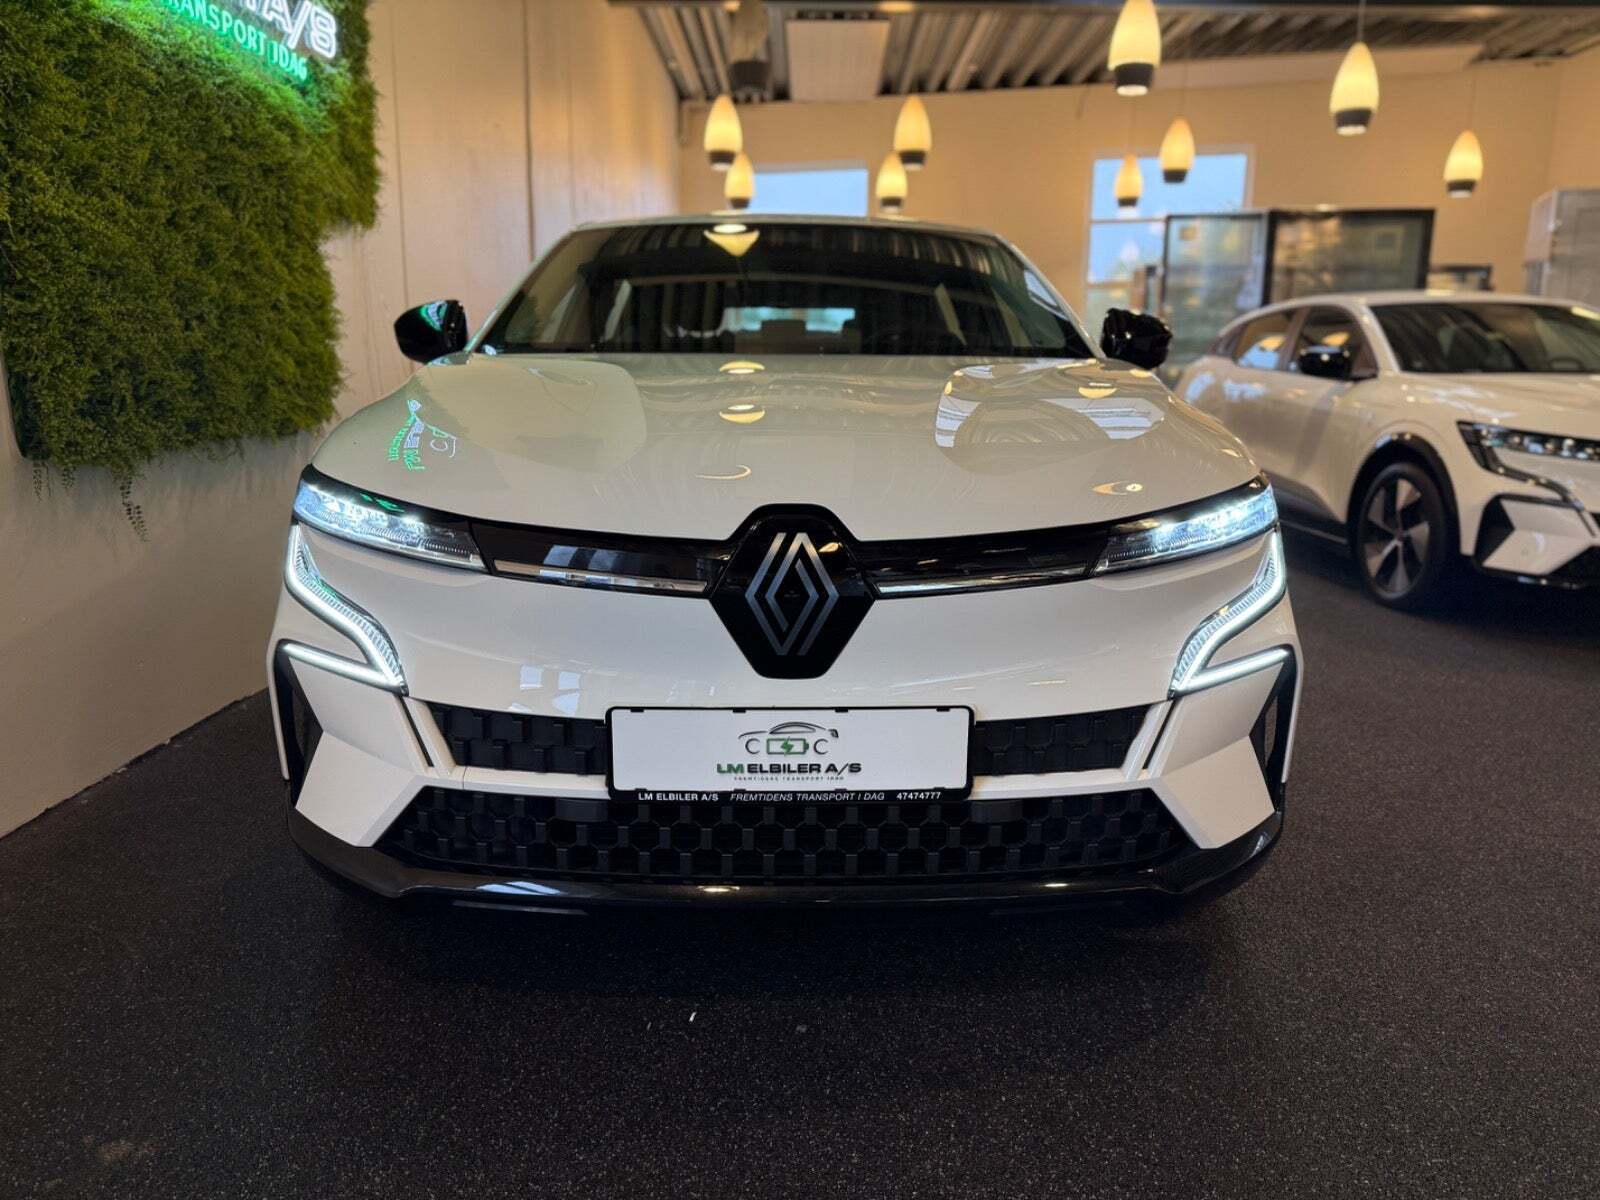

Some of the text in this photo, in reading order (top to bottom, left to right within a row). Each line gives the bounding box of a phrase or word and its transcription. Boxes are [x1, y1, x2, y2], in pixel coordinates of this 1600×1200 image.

[716, 763, 862, 776] LM ELBILER A/S
[638, 792, 653, 801] LM
[656, 792, 698, 801] ELBILER
[701, 792, 719, 801] A/S
[730, 793, 793, 801] FREMTIDENS
[796, 792, 855, 801] TRANSPORT
[864, 793, 885, 801] DAG
[896, 791, 941, 800] 47474777
